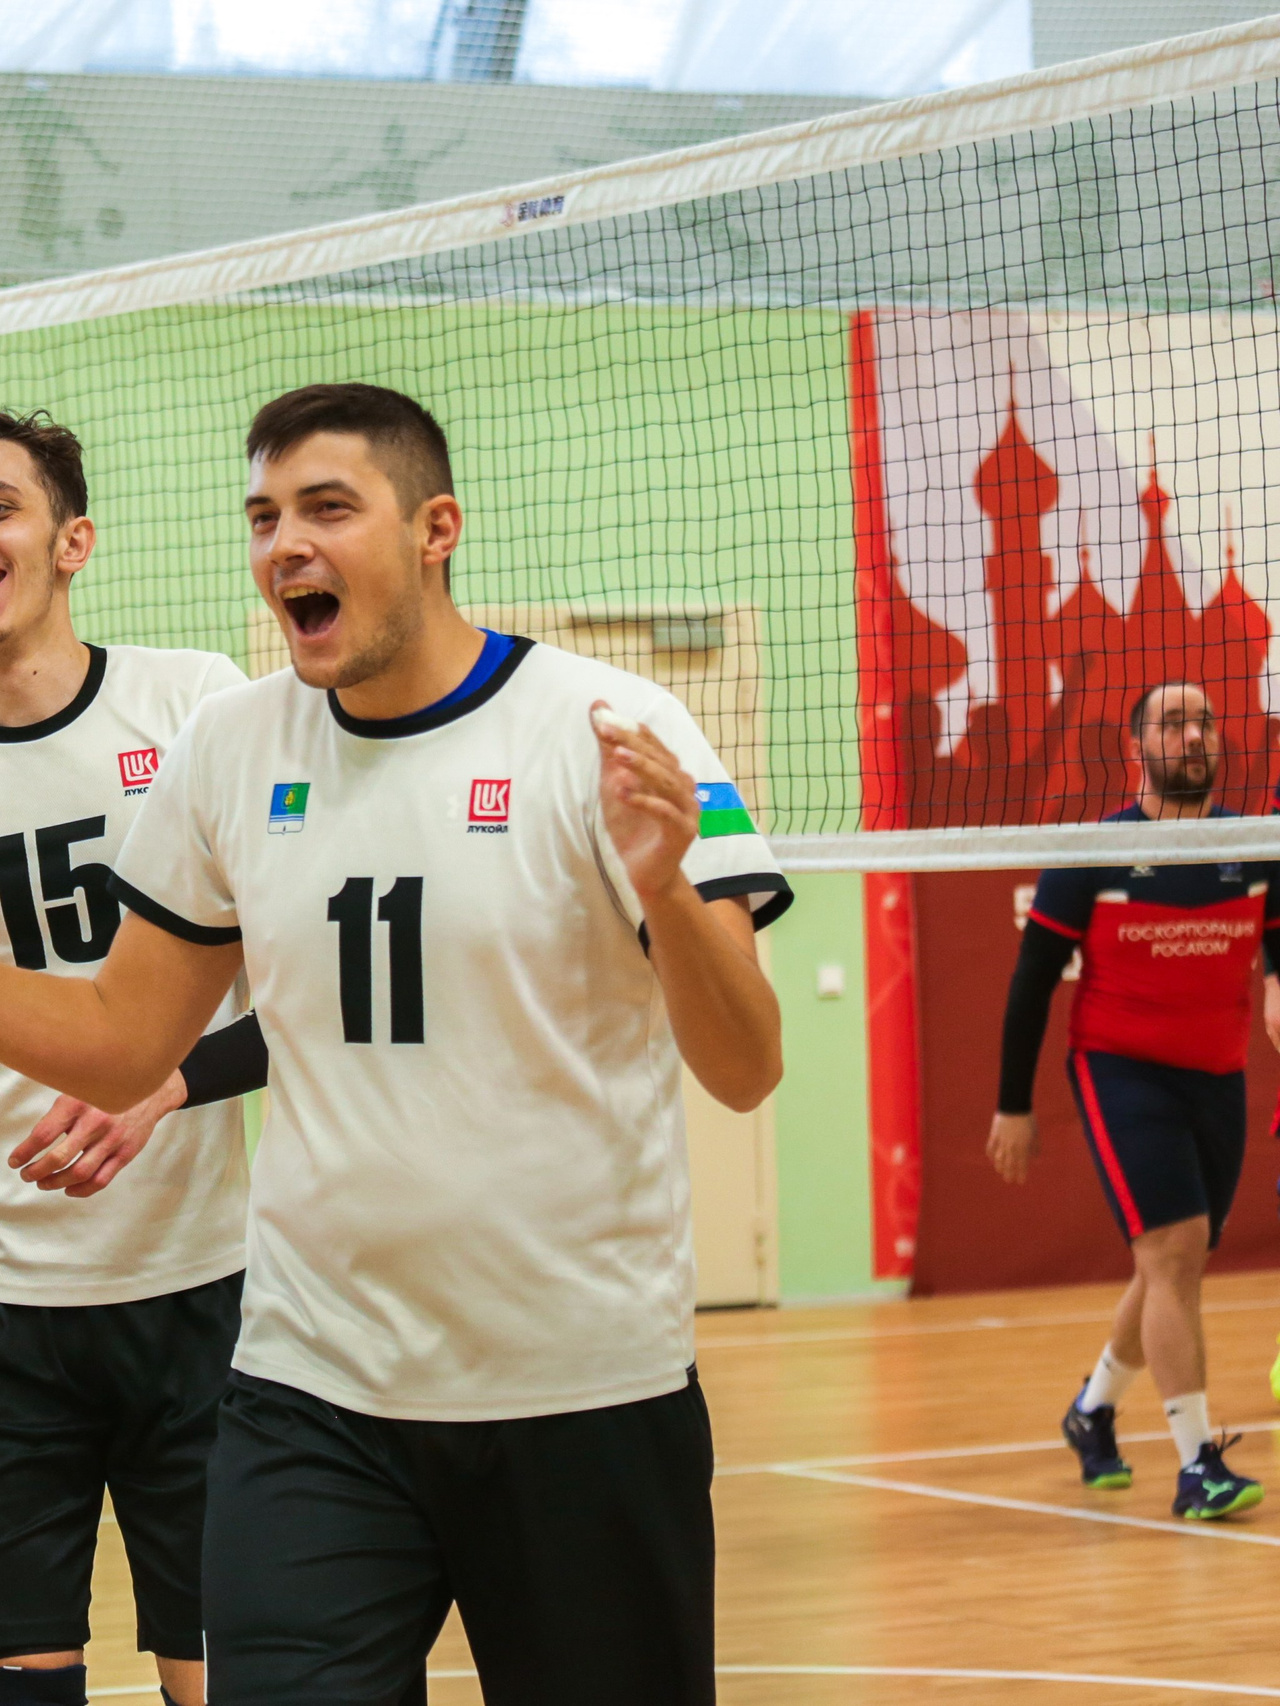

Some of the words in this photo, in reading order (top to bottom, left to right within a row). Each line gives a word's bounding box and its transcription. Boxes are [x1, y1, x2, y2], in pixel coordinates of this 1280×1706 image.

[466, 824, 508, 834] ЛУКОЙЛ
[1151, 940, 1230, 958] РОСАТОМ
[327, 877, 424, 1044] 11
